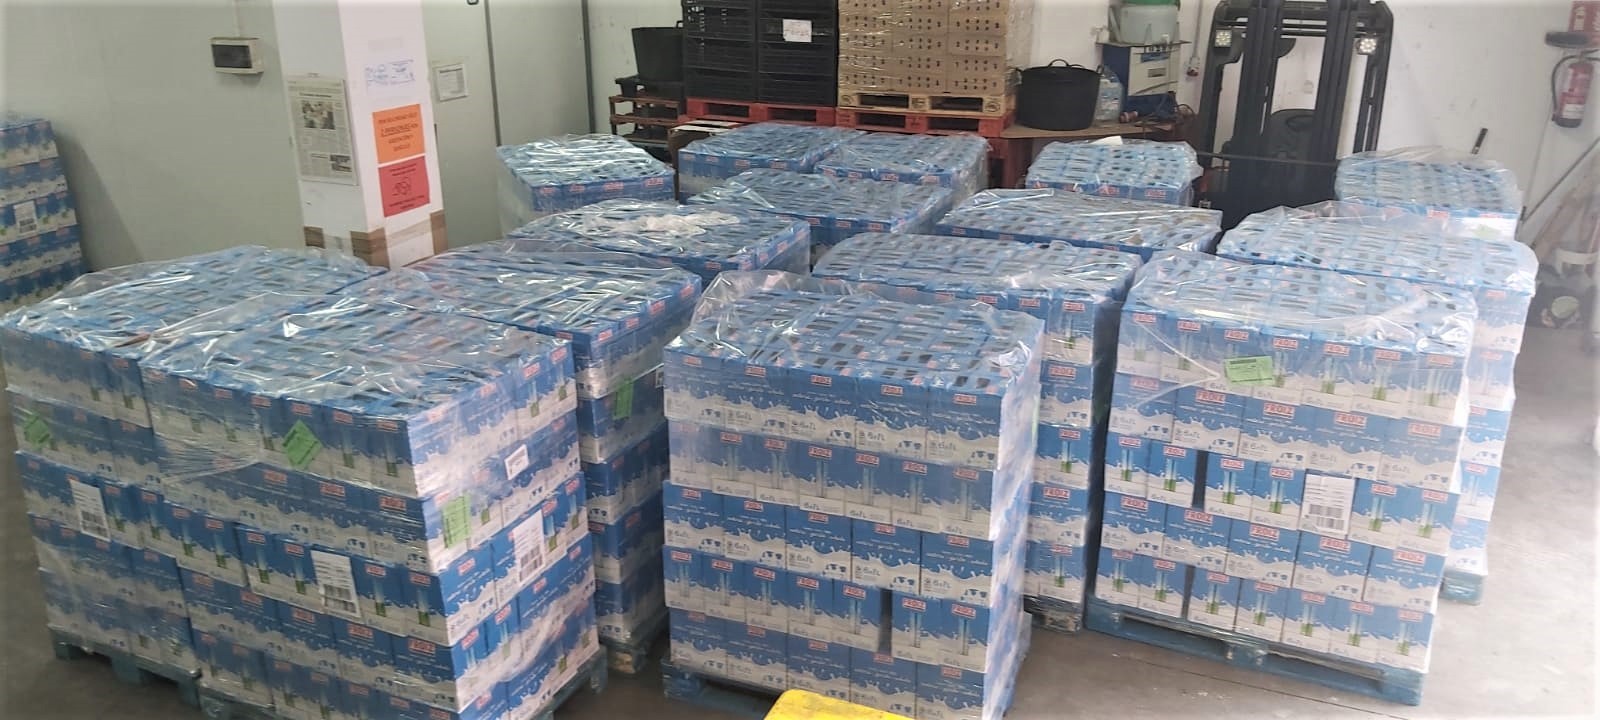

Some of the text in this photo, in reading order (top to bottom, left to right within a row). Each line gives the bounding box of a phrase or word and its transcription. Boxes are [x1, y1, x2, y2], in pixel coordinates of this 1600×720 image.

[1264, 403, 1294, 418] FROIZ
[1336, 413, 1366, 428] FROIZ
[1184, 510, 1213, 525] FROIZ
